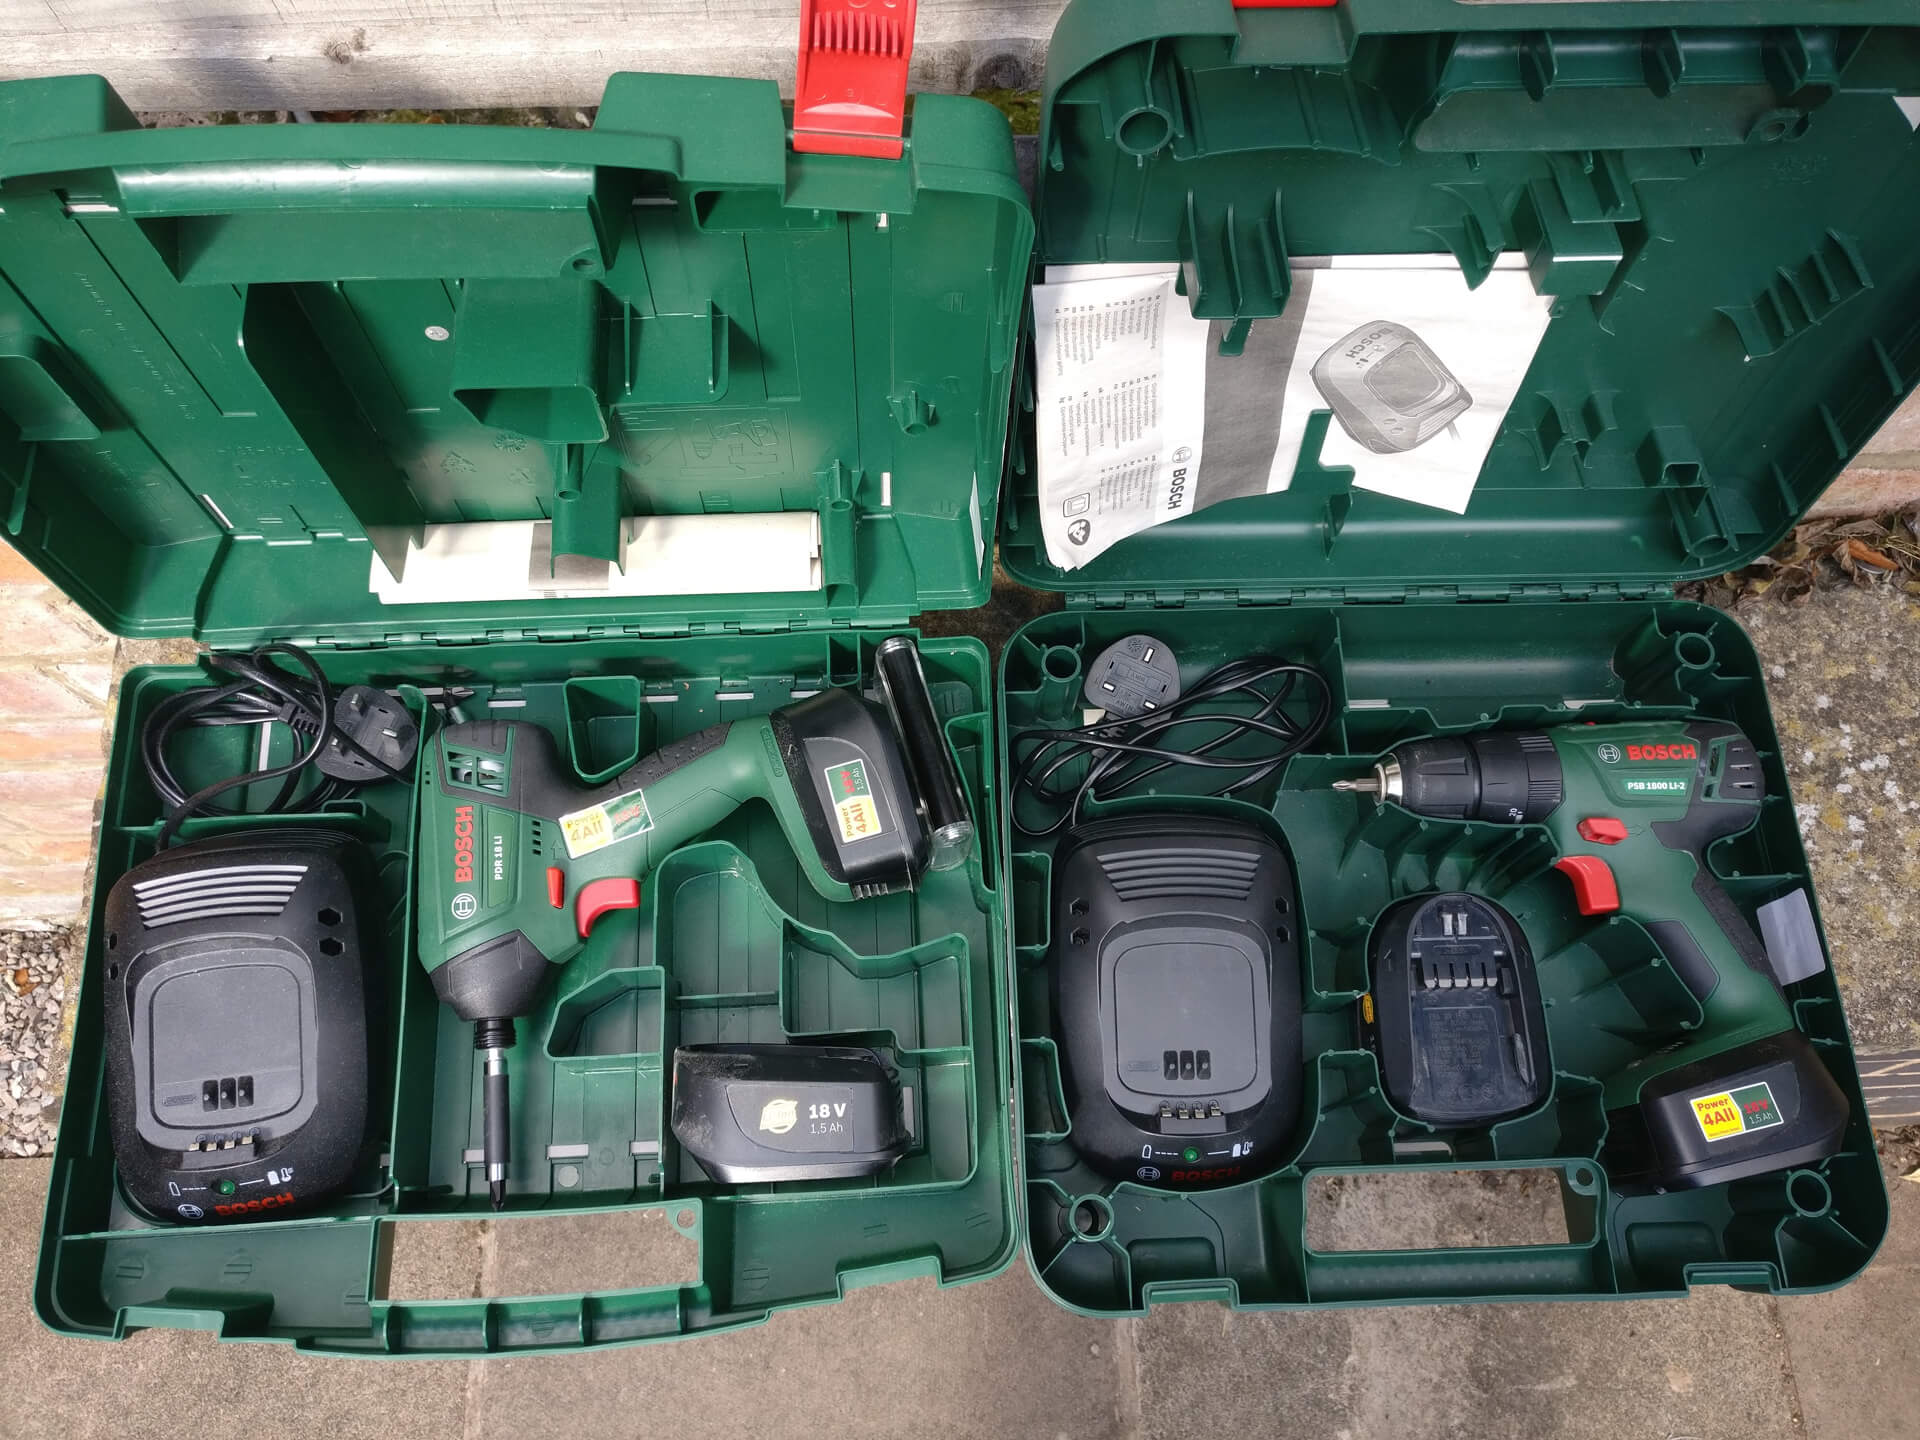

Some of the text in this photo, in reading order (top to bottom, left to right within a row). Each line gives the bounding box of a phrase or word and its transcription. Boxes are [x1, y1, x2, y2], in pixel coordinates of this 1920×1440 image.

[1167, 468, 1188, 510] BOSCH
[1626, 743, 1697, 761] BOSCH
[1627, 781, 1645, 790] PSB
[1647, 781, 1668, 790] 1800
[842, 807, 854, 837] Power
[849, 803, 867, 833] 4All
[571, 820, 604, 841] 4All
[455, 805, 474, 883] BOSCH
[494, 847, 503, 859] 18
[494, 861, 503, 880] PDR
[1697, 1098, 1728, 1112] Power
[1703, 1107, 1735, 1126] 4All
[1171, 1166, 1241, 1182] BOSCH
[214, 1192, 296, 1216] BOSCH
